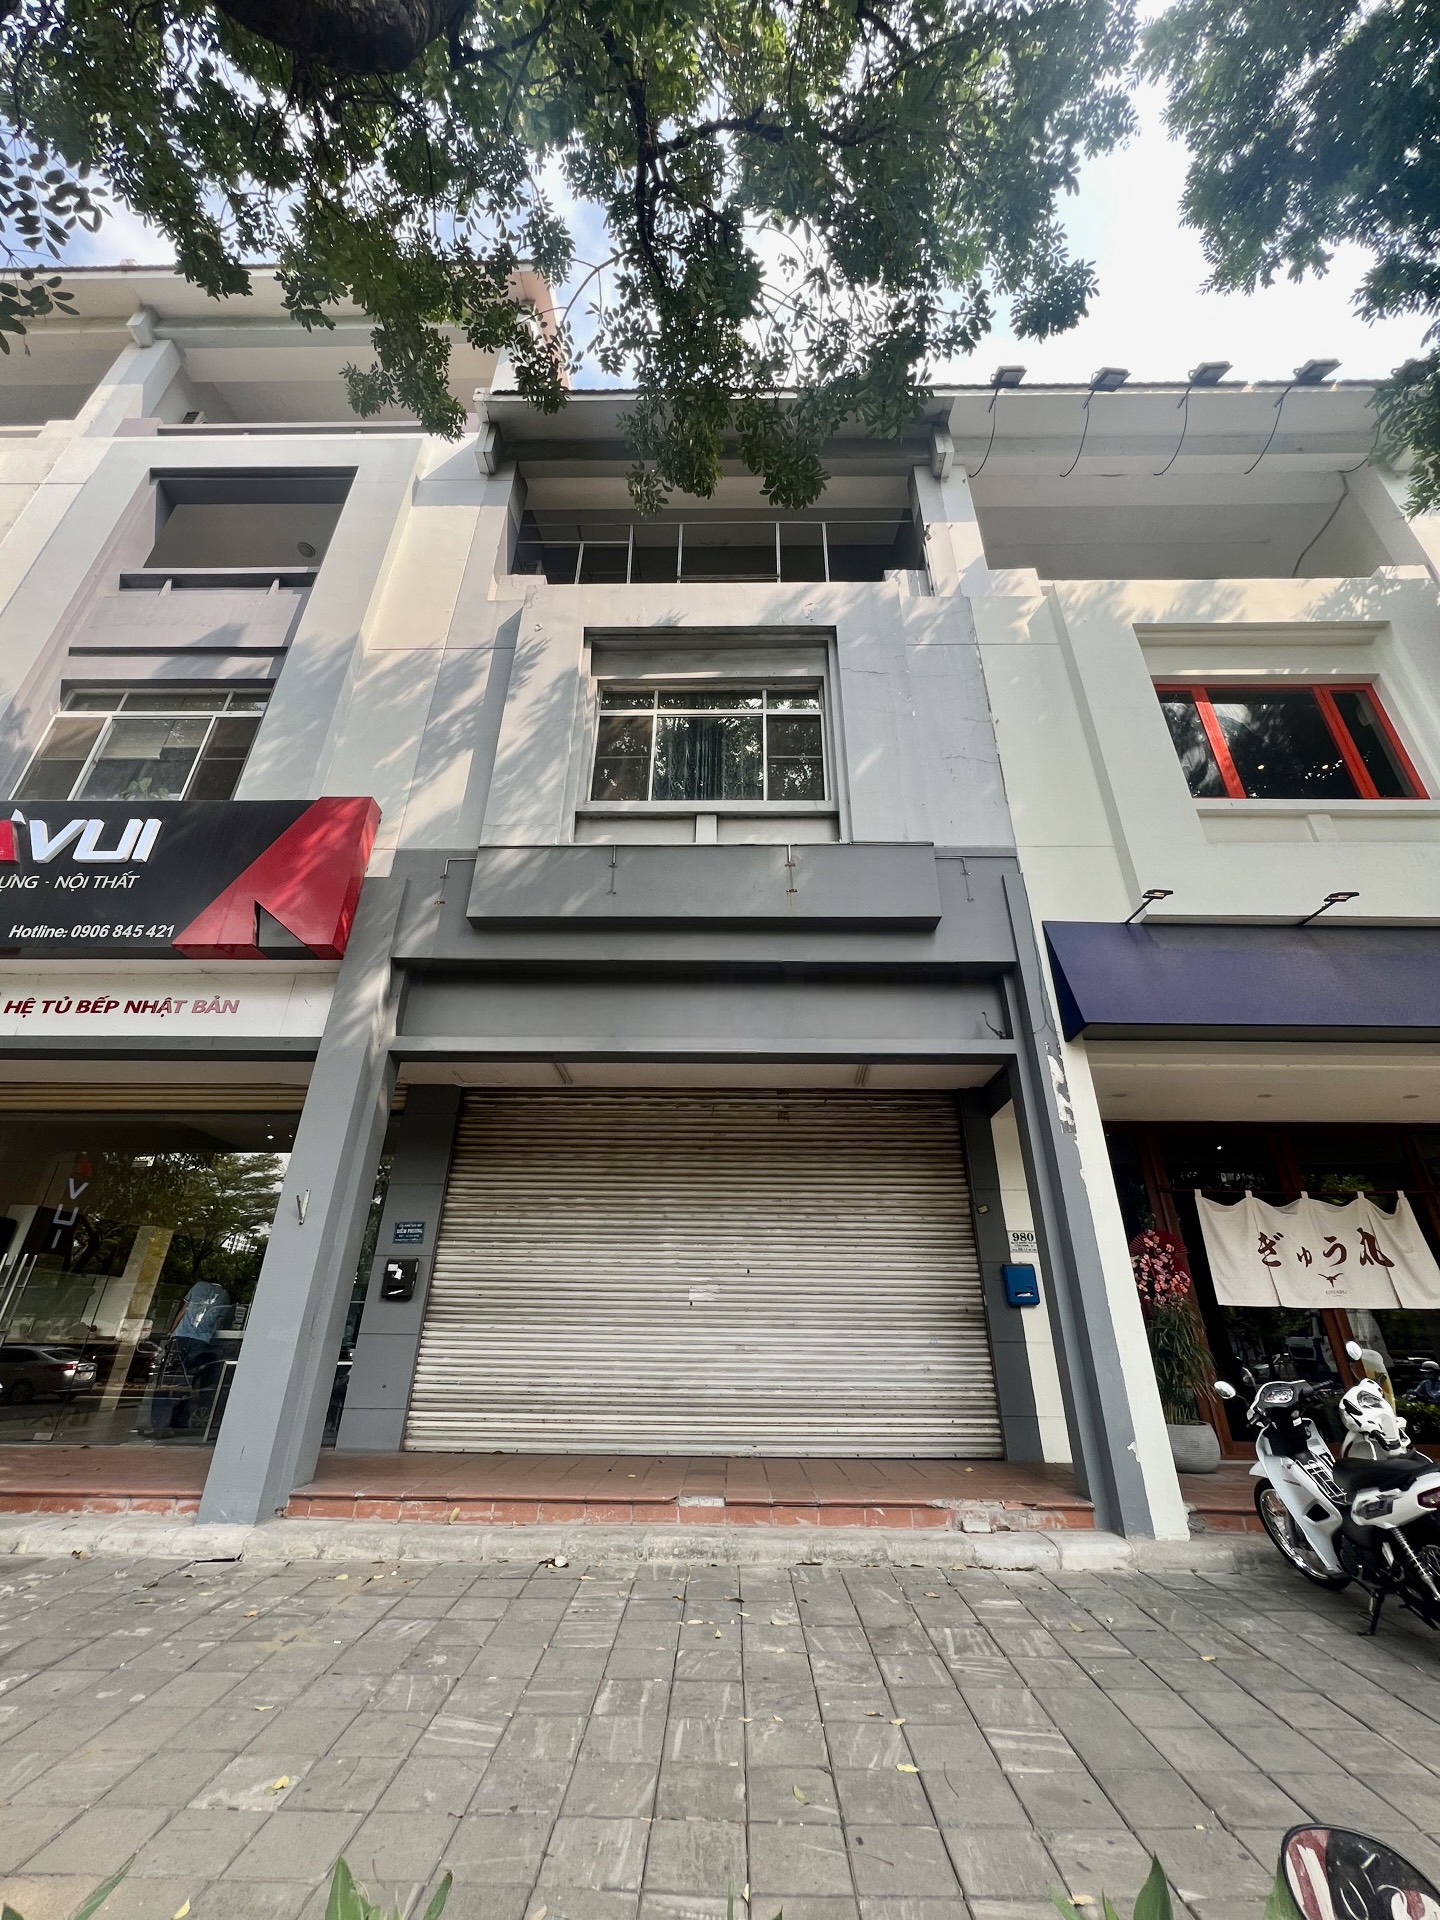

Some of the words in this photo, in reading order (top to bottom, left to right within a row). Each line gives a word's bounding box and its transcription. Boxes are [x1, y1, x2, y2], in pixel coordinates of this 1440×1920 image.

[54, 872, 89, 892] NỘI
[93, 870, 140, 889] THẤT
[8, 924, 68, 938] Hotline:
[70, 924, 110, 938] 0906
[112, 924, 144, 938] 845
[145, 924, 175, 938] 421
[4, 997, 36, 1018] HỆ
[42, 996, 73, 1014] TỦ
[75, 995, 120, 1014] BẾP
[124, 997, 188, 1018] NHẬT
[192, 995, 240, 1014] BẢN
[1012, 1232, 1034, 1242] 980
[1258, 1227, 1395, 1268] ぎゅう丸
